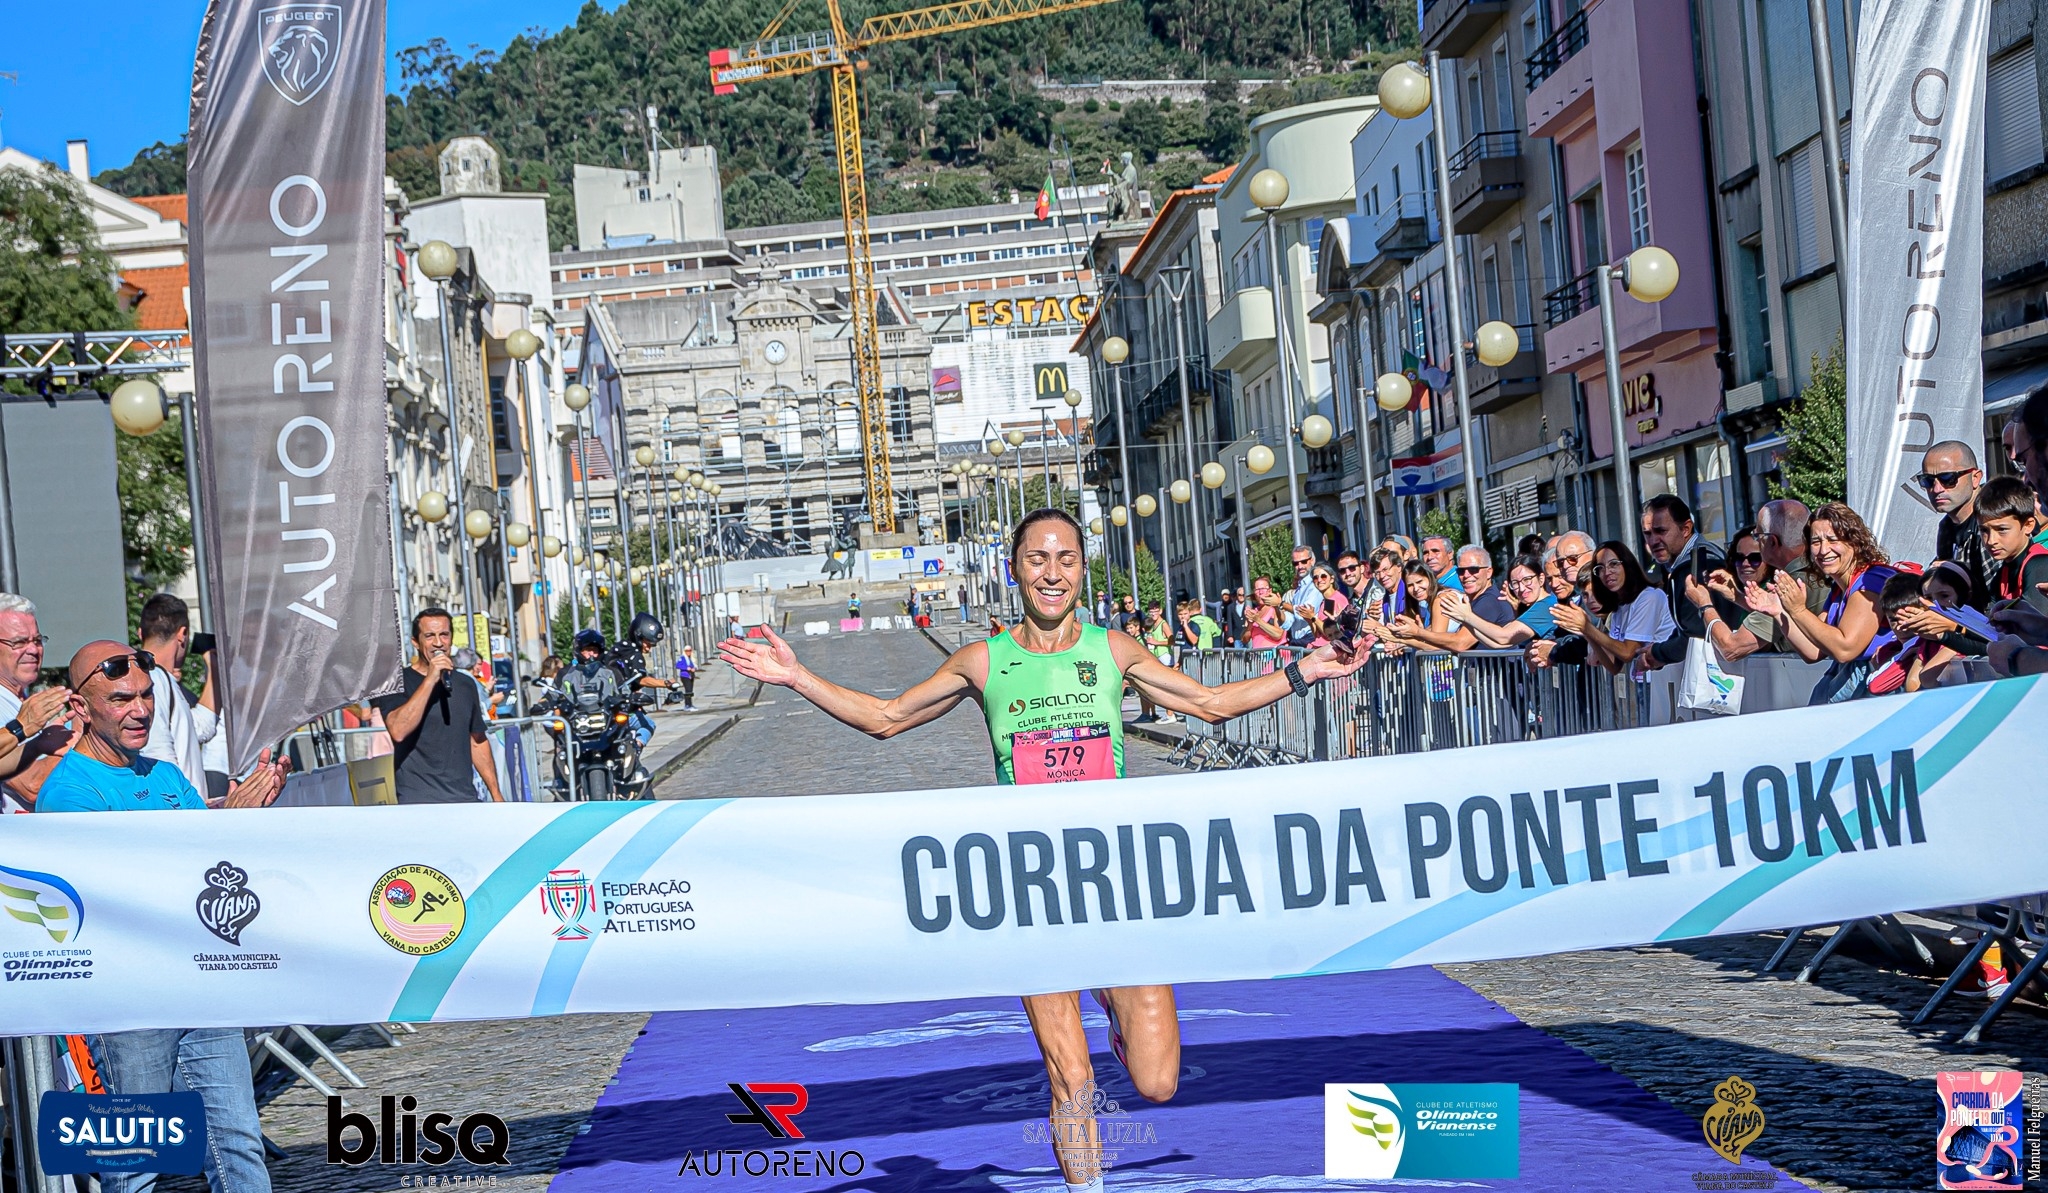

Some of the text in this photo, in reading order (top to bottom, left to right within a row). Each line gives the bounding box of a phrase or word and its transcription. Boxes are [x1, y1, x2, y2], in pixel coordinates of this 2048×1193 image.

[265, 11, 334, 25] PEUGEOT
[1907, 67, 1949, 279] RENO
[968, 294, 1104, 328] ESTAÇ
[269, 174, 337, 630] AUTO RENO
[1017, 711, 1094, 728] CLUBE ATLÉTICO
[1044, 745, 1085, 767] 579
[1047, 768, 1085, 778] MÓNICA
[901, 748, 1927, 933] CORRIDA DA PONTE 10KM
[372, 866, 460, 906] ASSOCIAÇÃO DE ATLETISMO
[602, 880, 691, 897] FEDERAÇÃO
[604, 901, 694, 915] PORTUGUESA
[602, 918, 695, 933] ATLETISMO
[383, 931, 406, 951] VIANA
[423, 930, 456, 953] CASTELO
[47, 949, 92, 957] ATLETISMO
[193, 953, 281, 962] CÂMARA MUNICIPAL
[4, 958, 93, 970] Olímpico
[198, 962, 278, 971] VIANA DO CASTELO
[5, 971, 93, 981] Vianense
